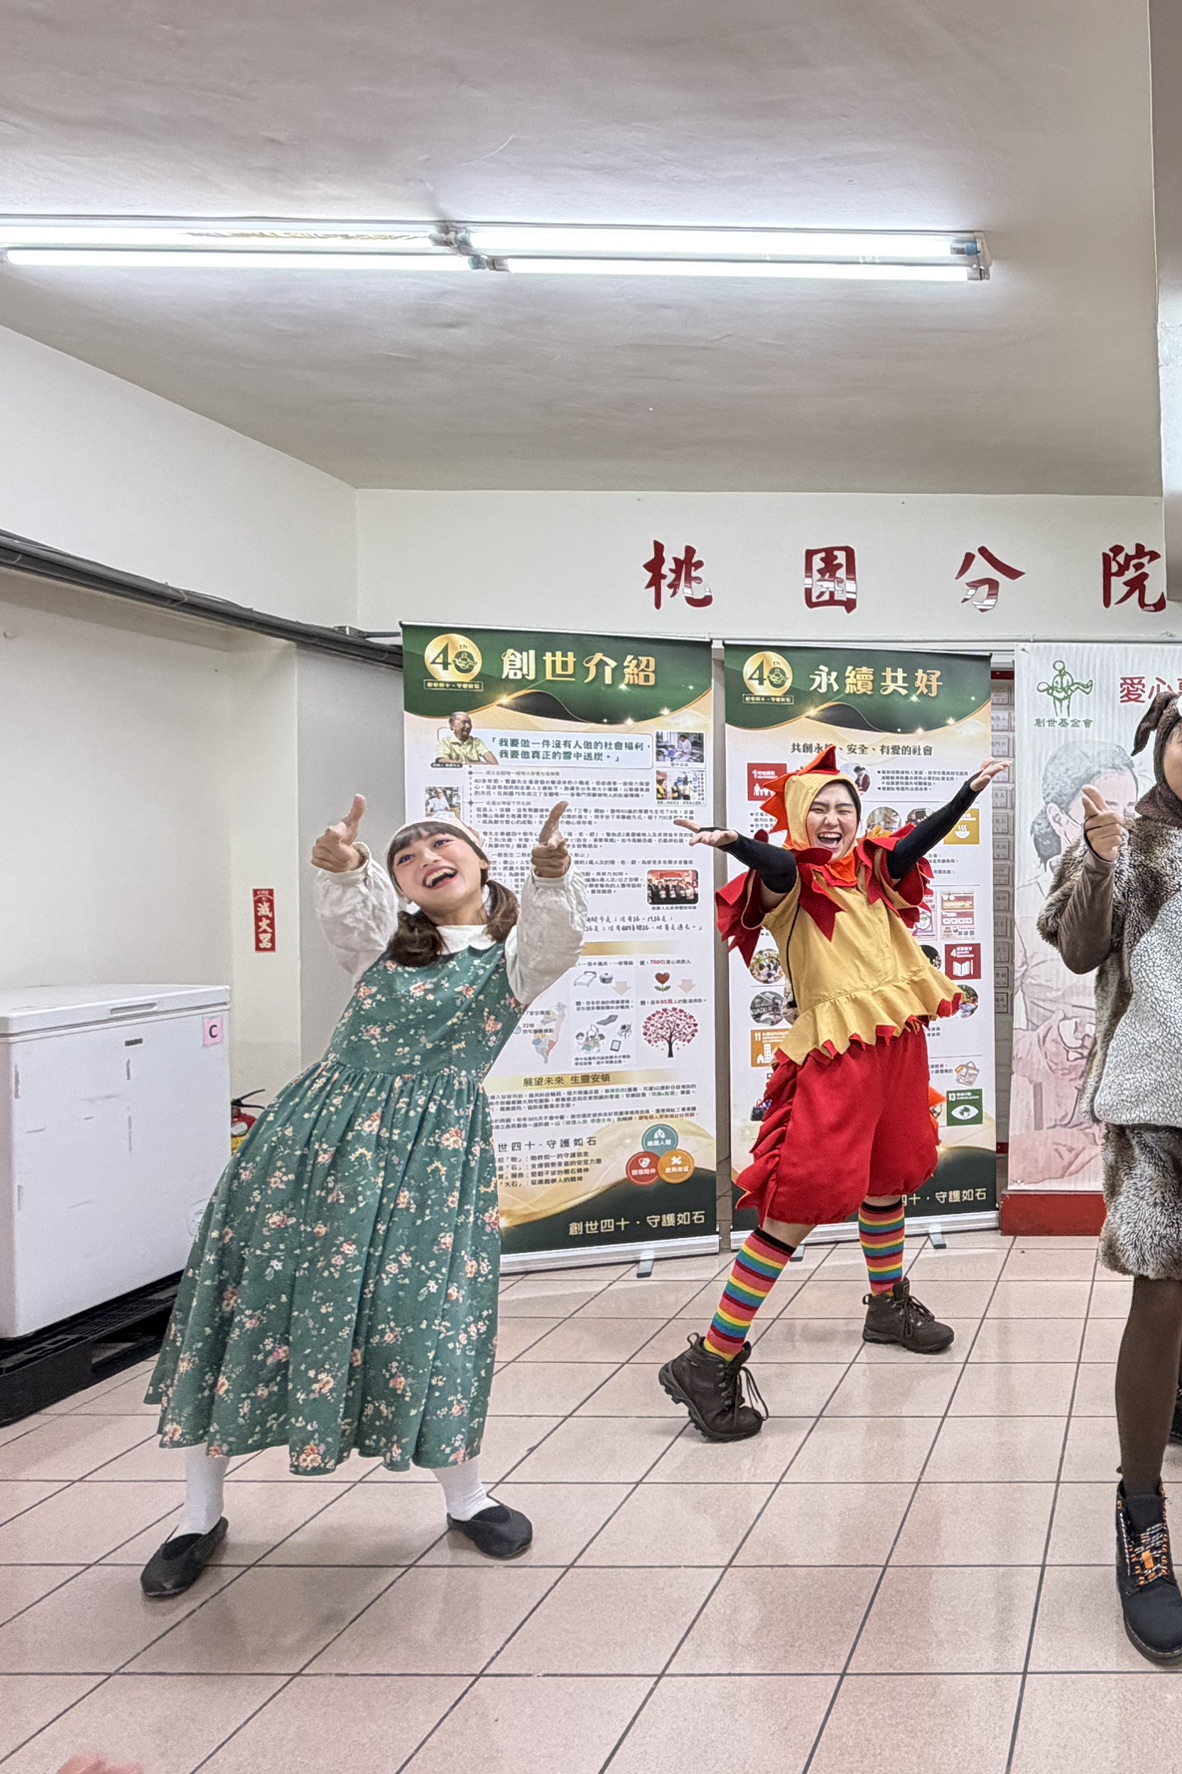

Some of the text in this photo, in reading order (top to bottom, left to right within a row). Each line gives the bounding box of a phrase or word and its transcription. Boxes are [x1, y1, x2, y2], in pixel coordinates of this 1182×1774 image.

[501, 648, 657, 686] 創世介紹
[809, 665, 943, 698] 永續共好
[1034, 718, 1094, 728] 創世基金會
[256, 901, 273, 949] 滅火器
[208, 1024, 218, 1038] C
[523, 1076, 564, 1087] 展望未來
[568, 1210, 706, 1236] 創世四十·守護如石
